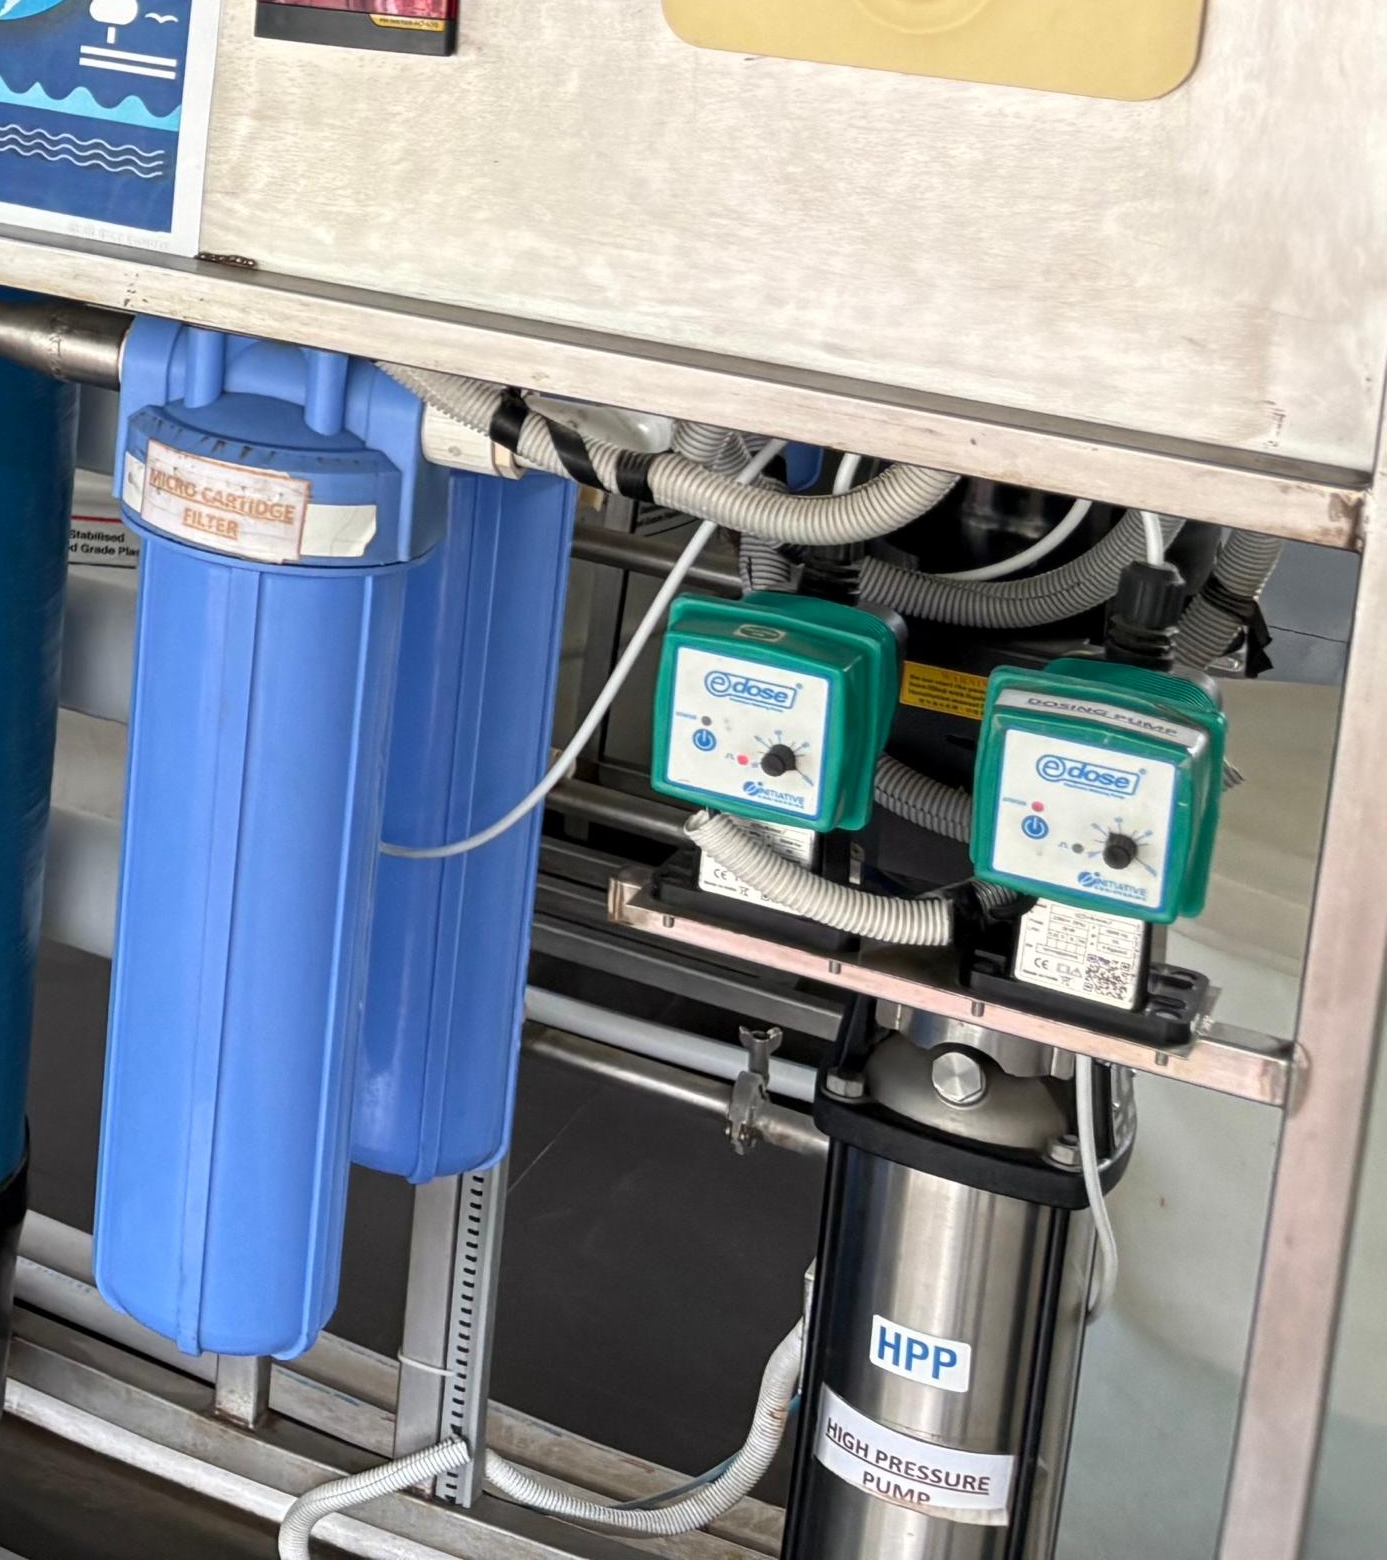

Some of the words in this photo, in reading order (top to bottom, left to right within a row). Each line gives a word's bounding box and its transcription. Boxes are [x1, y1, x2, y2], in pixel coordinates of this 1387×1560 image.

[149, 469, 197, 498] MICRO
[201, 487, 296, 523] CARTIDGE
[183, 507, 239, 538] FILTER
[81, 544, 115, 555] Grade
[1027, 697, 1107, 717] DOSING
[1114, 713, 1179, 737] PUMP
[877, 1325, 958, 1380] HPP
[827, 1417, 869, 1458] HIGH
[875, 1448, 990, 1492] PRESSURE
[863, 1471, 931, 1505] PUMP
